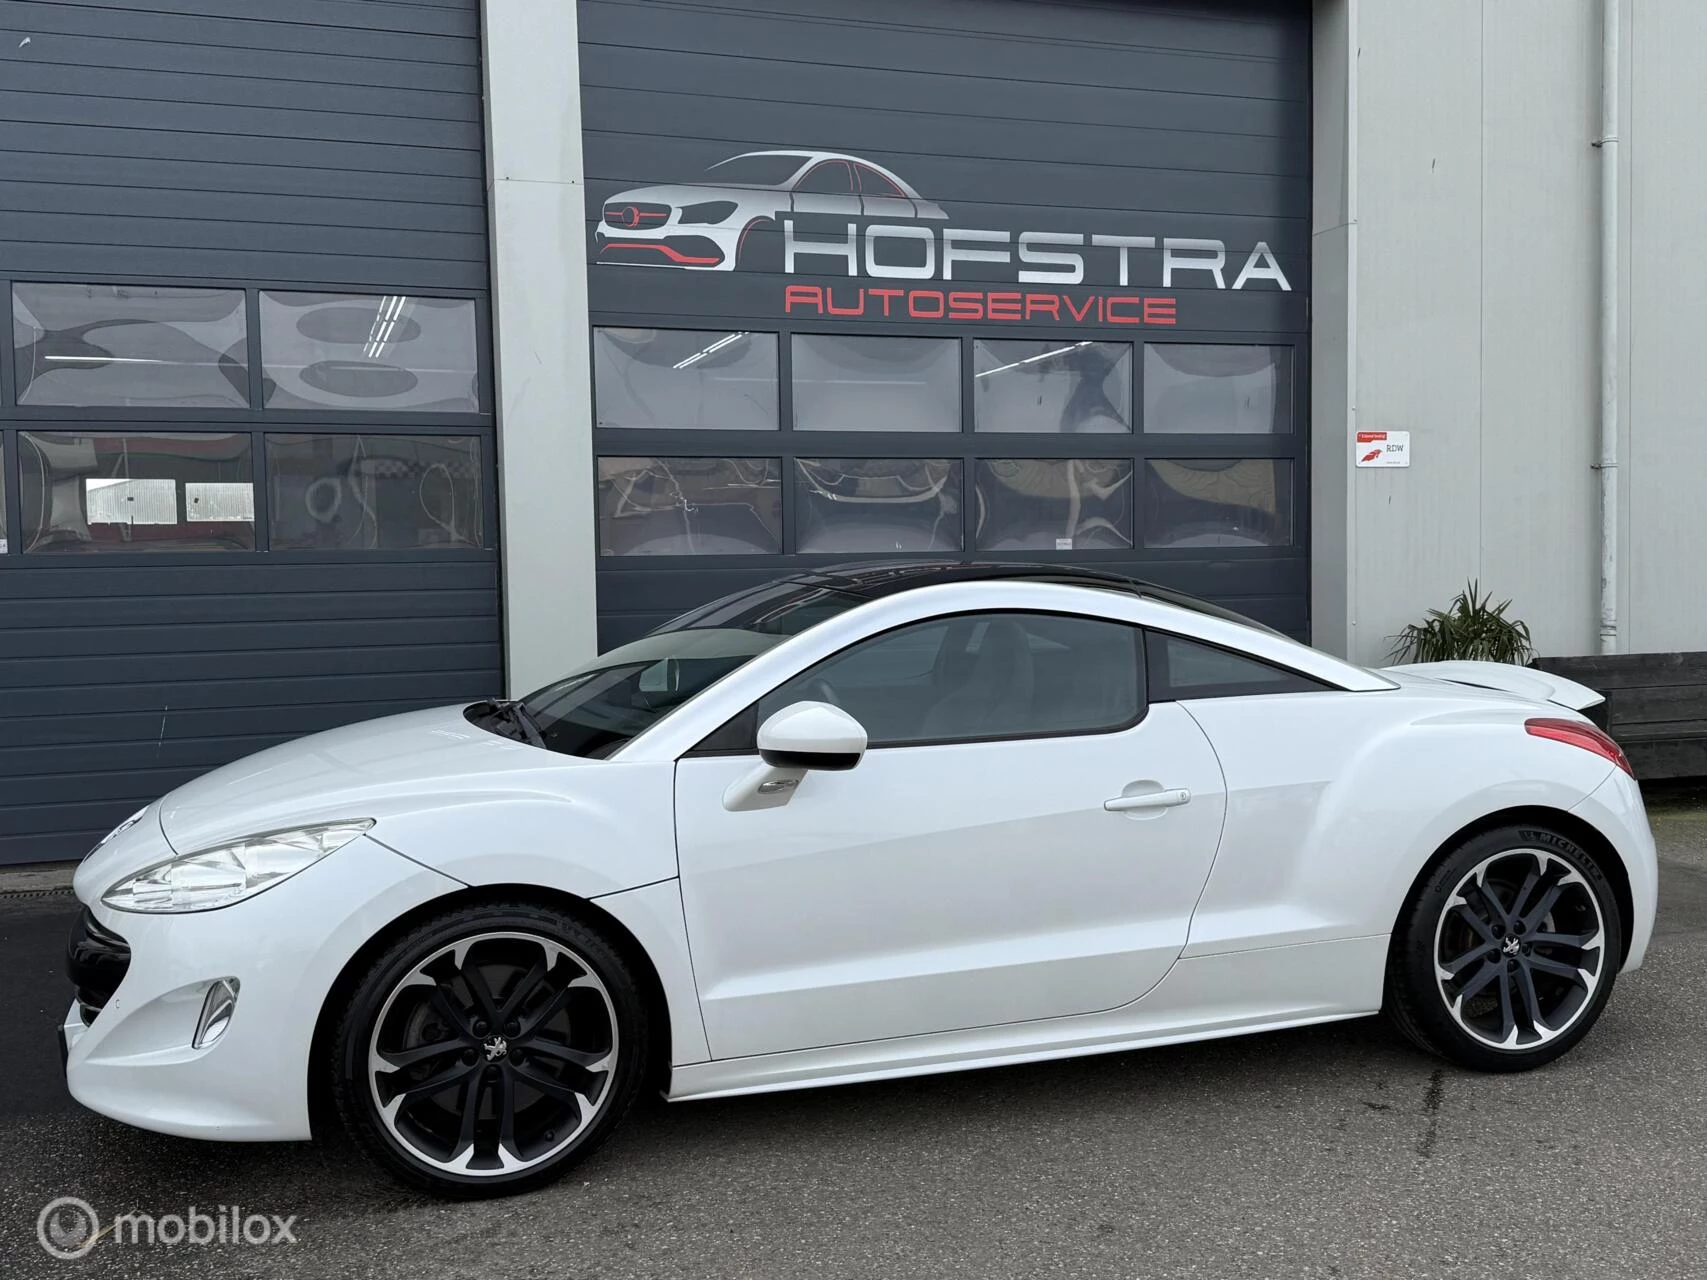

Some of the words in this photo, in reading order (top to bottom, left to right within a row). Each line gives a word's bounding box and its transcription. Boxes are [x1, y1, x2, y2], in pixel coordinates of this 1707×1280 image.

[783, 218, 1293, 292] HOFSTRA
[784, 285, 1178, 326] AUTOSERVICE
[1386, 444, 1404, 452] RDW
